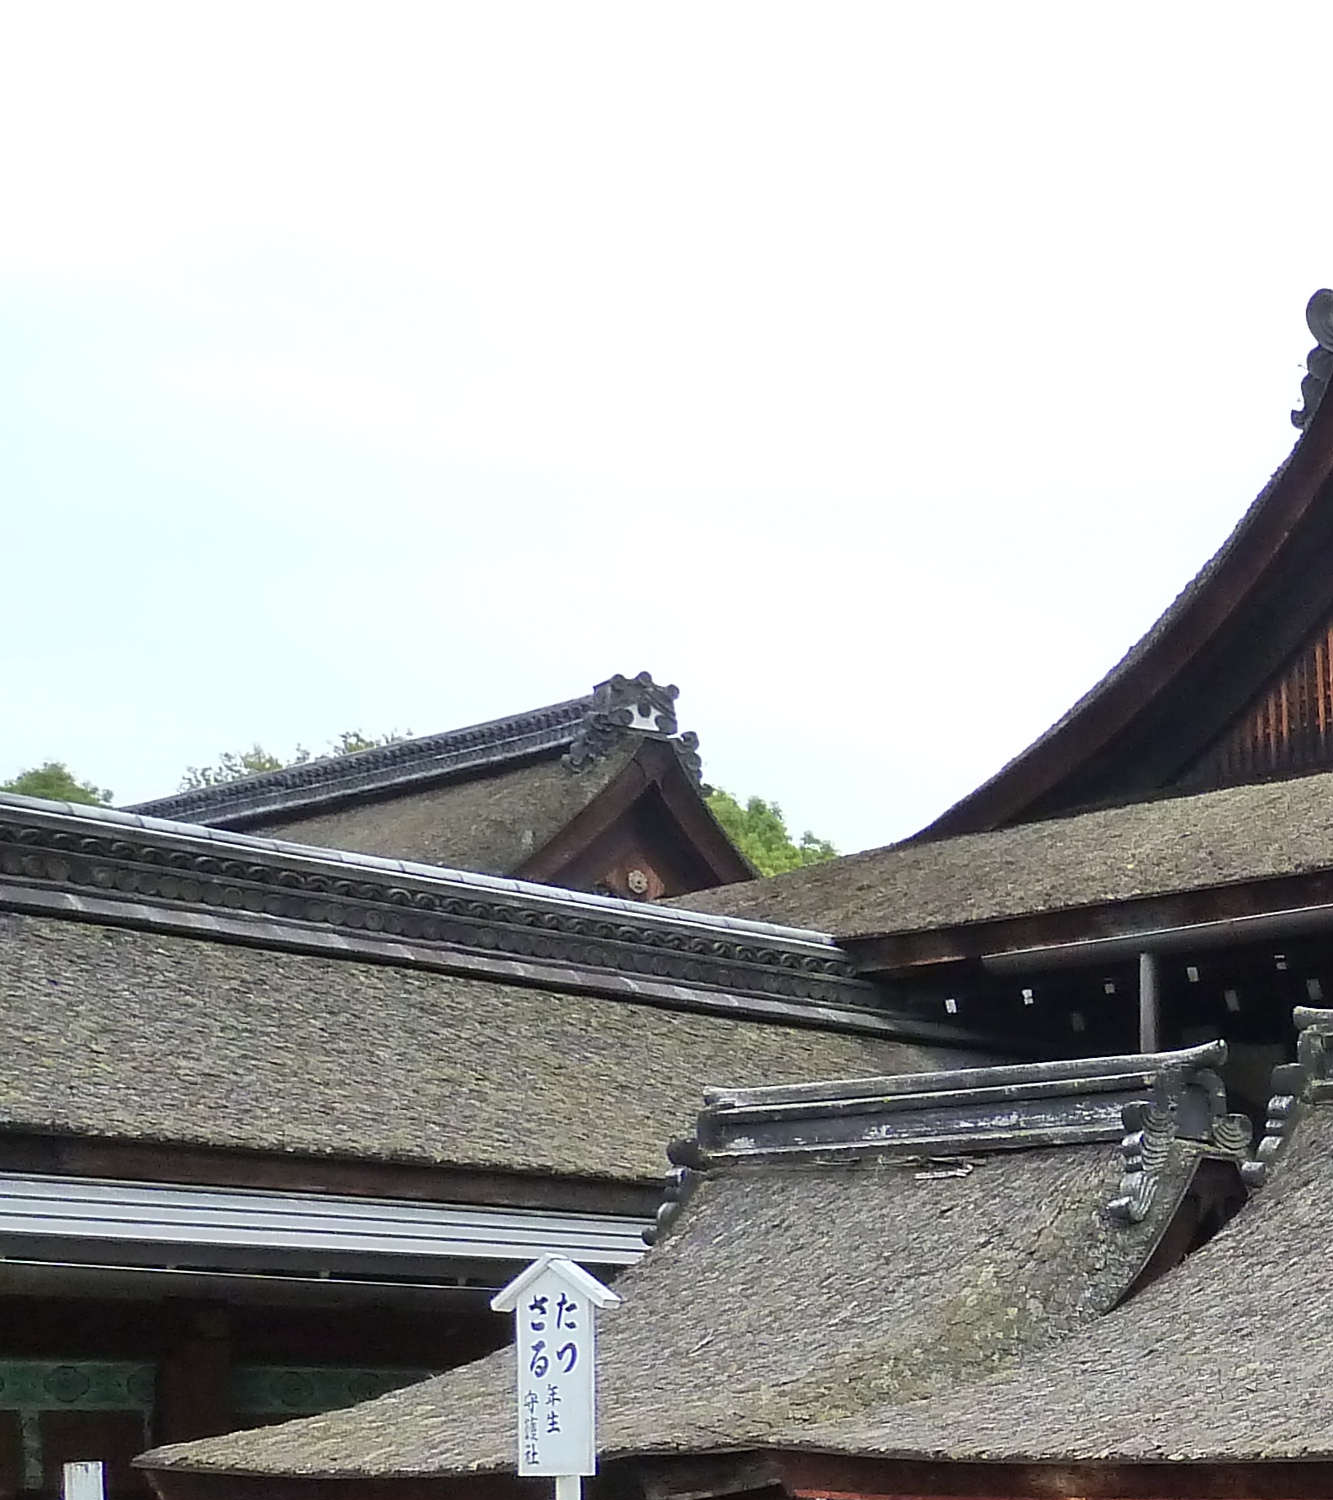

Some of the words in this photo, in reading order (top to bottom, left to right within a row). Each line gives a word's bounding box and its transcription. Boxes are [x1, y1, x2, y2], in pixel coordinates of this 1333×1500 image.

[528, 1293, 550, 1379] さる
[555, 1292, 578, 1374] たつ
[523, 1389, 540, 1466] 守護社
[544, 1383, 562, 1434] 年生
